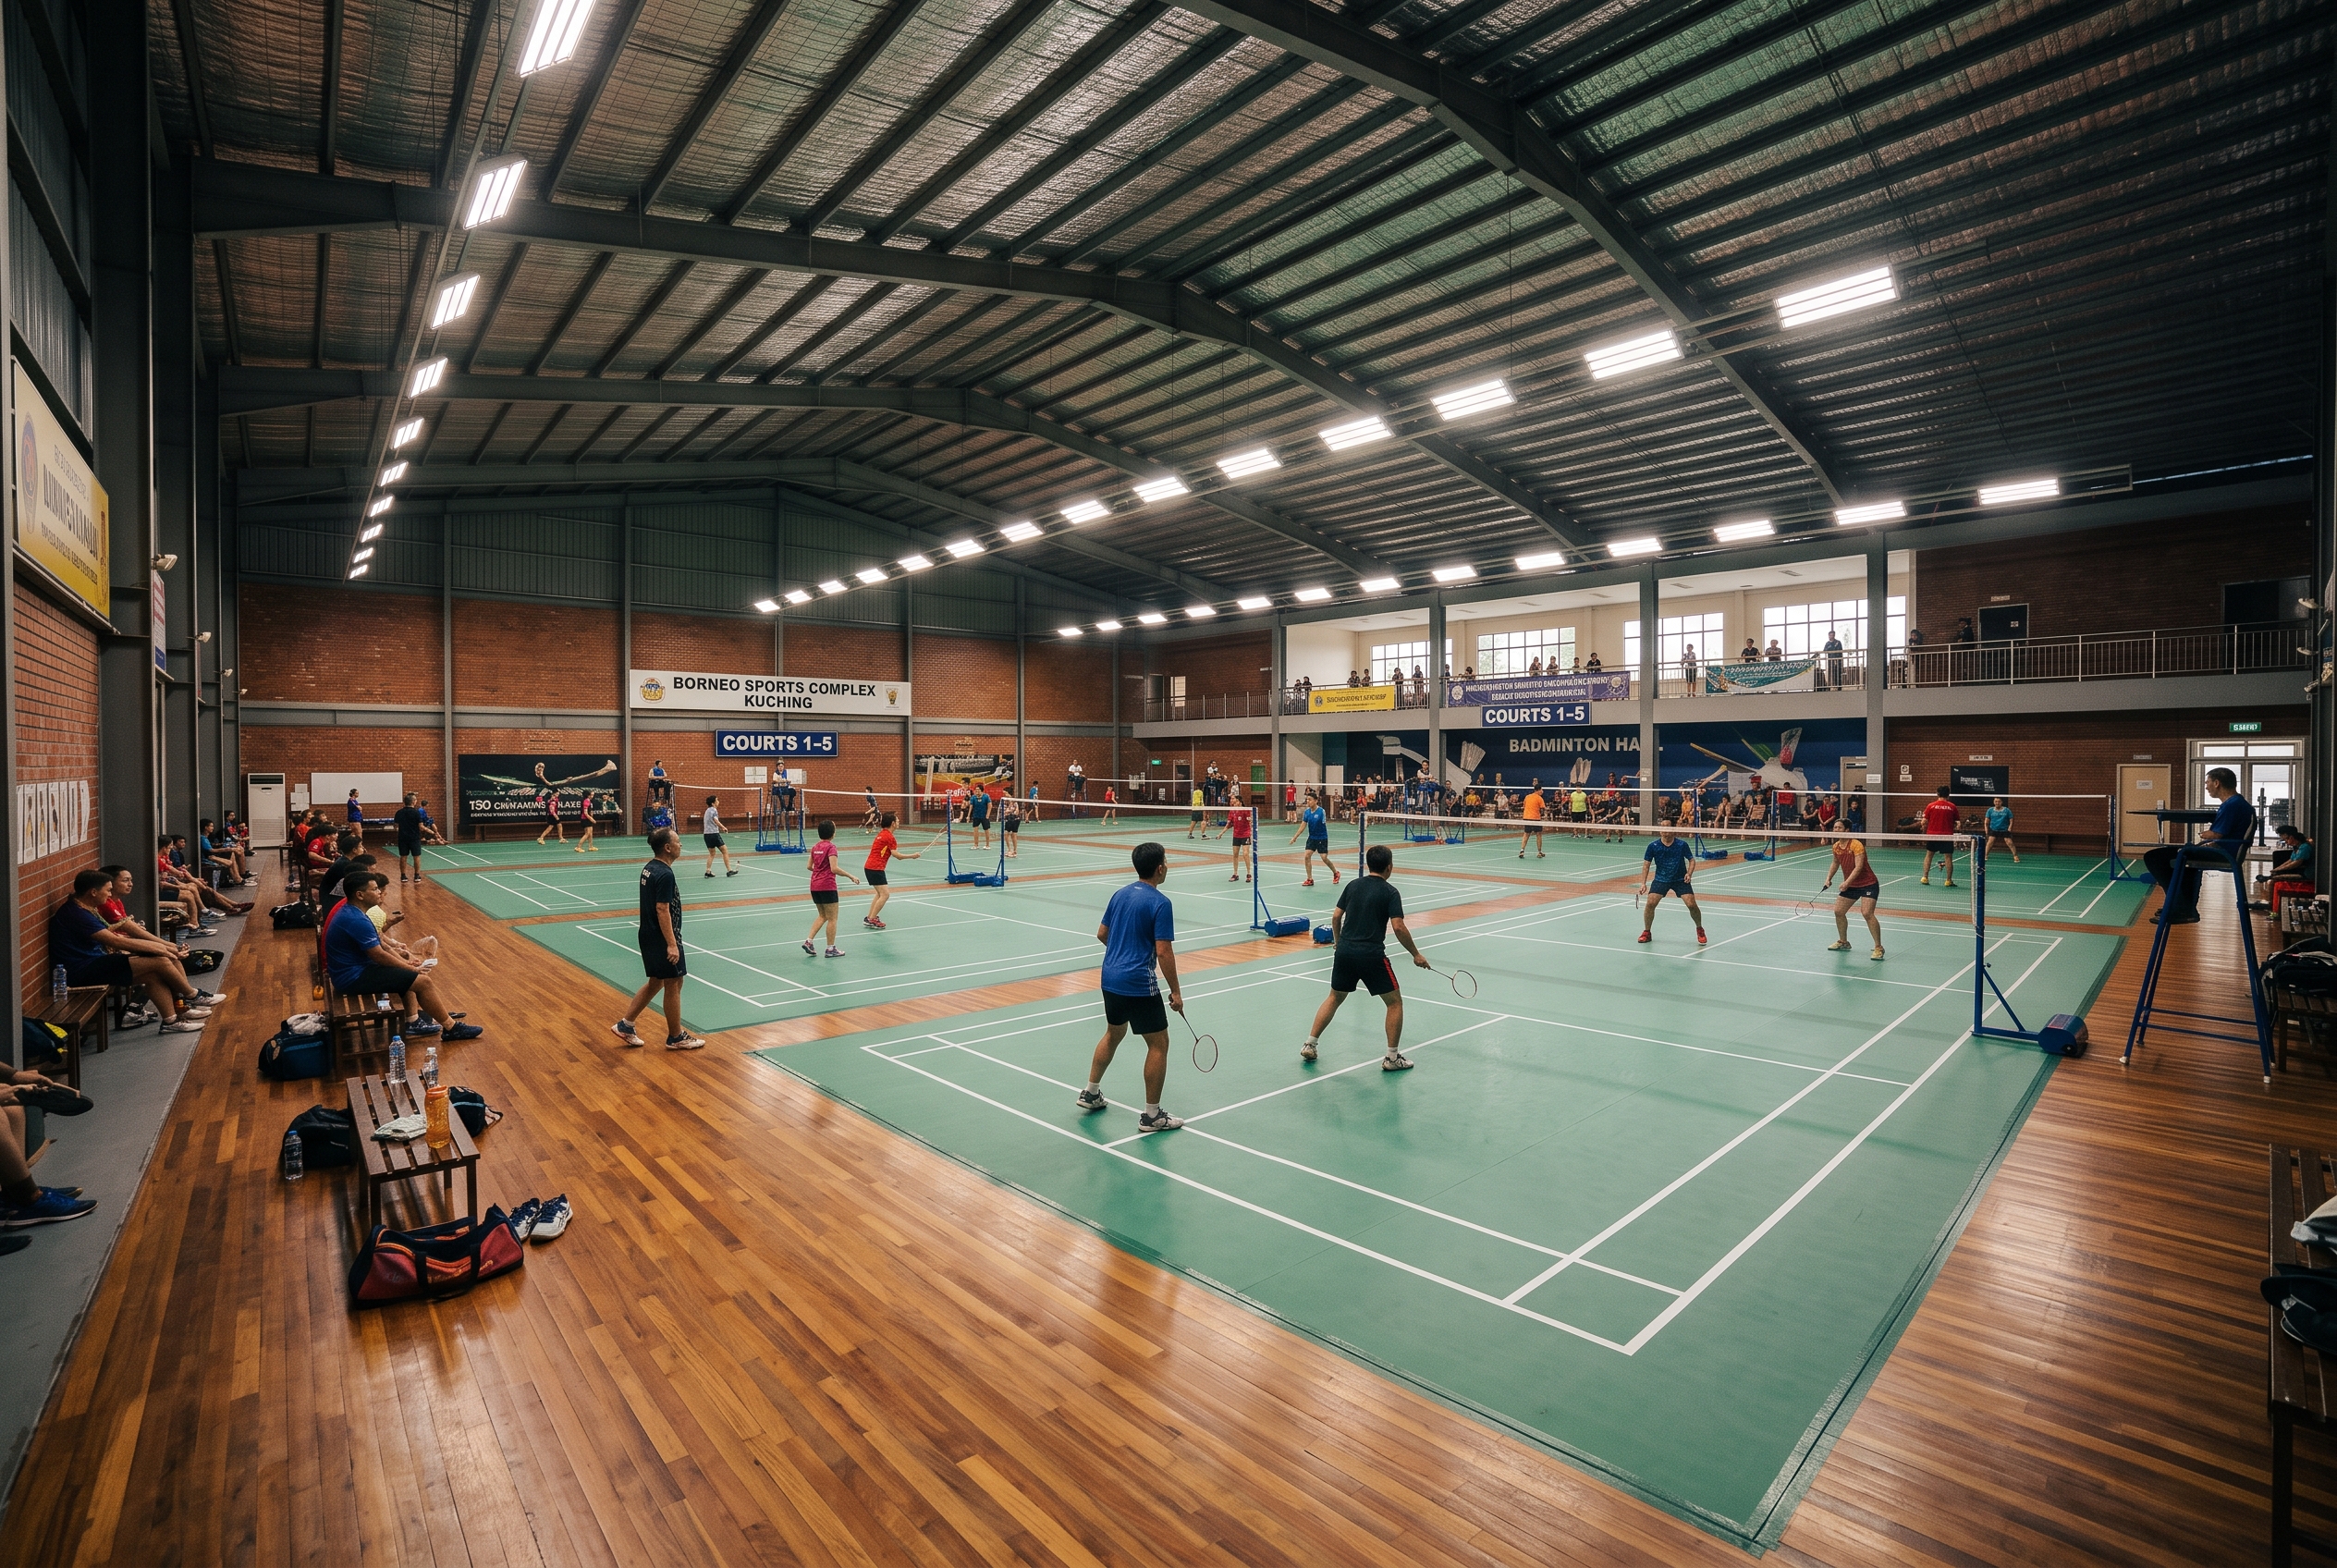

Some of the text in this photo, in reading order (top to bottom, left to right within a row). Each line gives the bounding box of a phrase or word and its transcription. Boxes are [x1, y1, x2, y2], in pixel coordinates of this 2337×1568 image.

[673, 676, 876, 697] BORNEO SPORTS COMPLEX
[744, 694, 813, 709] KUCHING
[1485, 707, 1551, 724] COURTS
[722, 734, 798, 751] COURTS
[1509, 737, 1609, 753] BADMINTON
